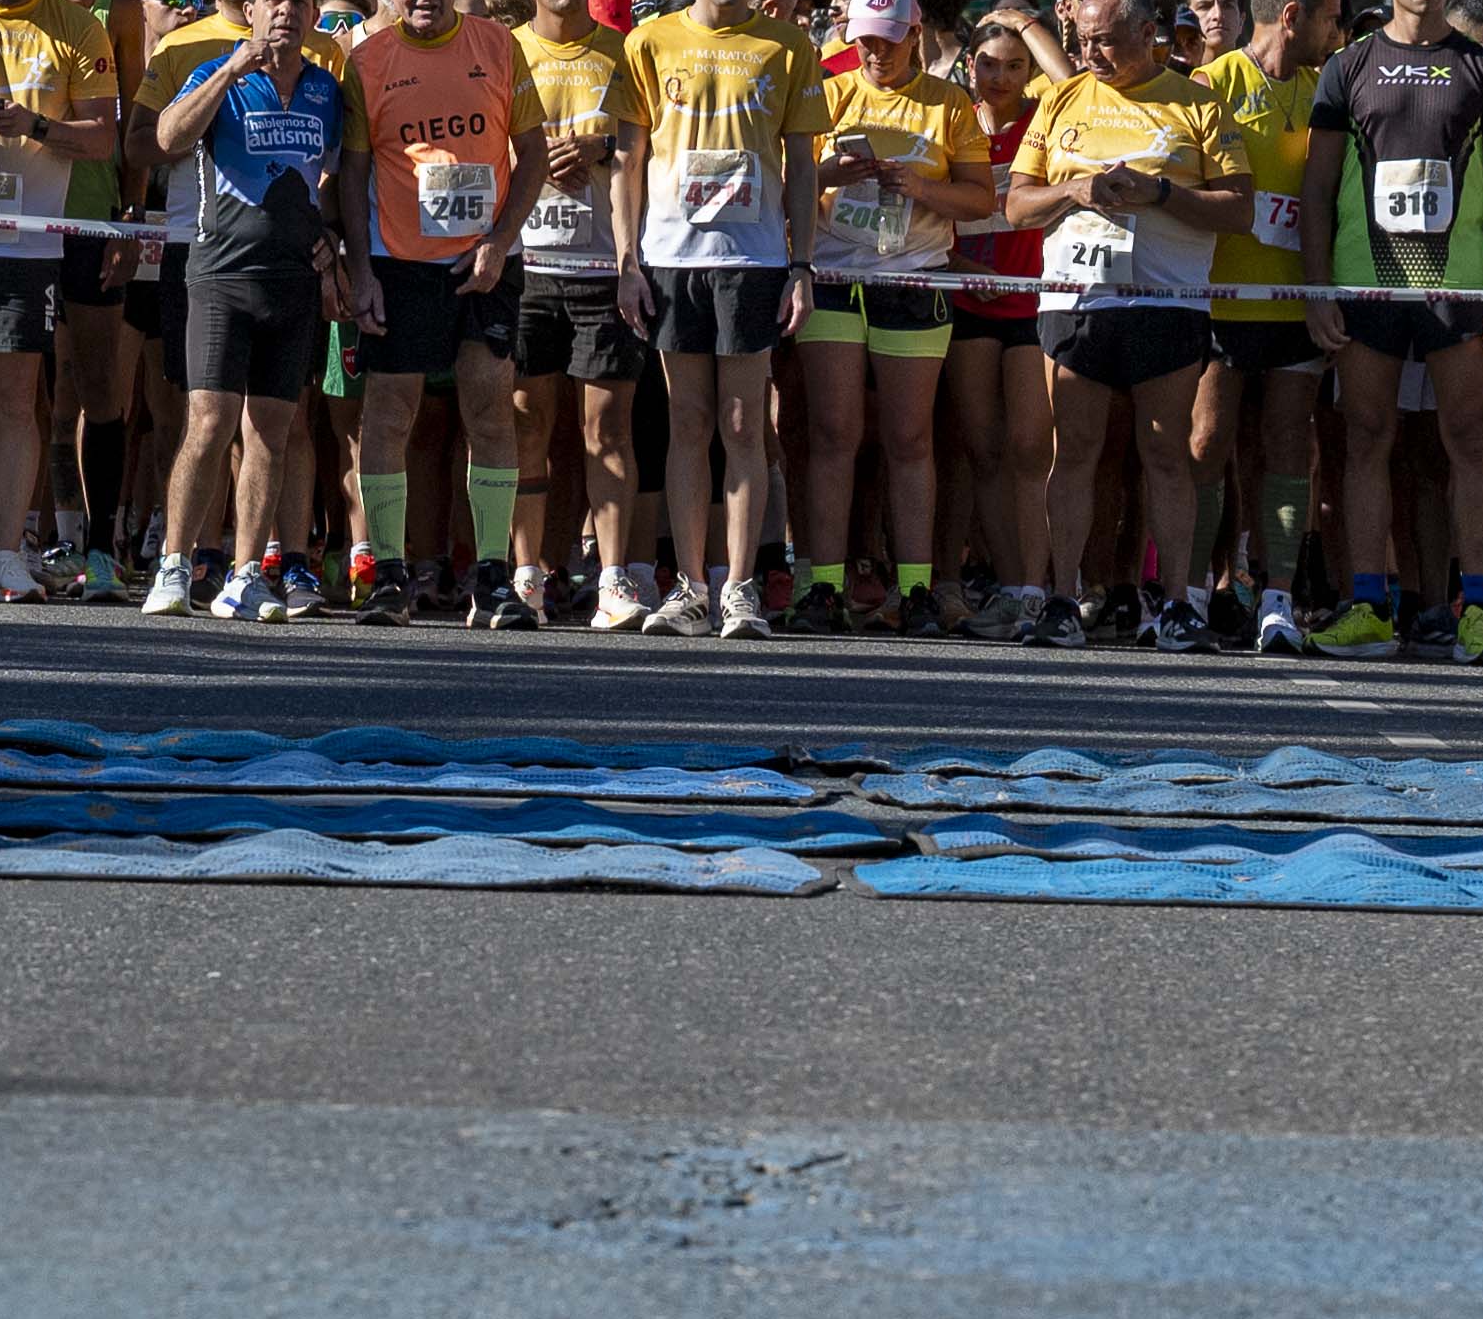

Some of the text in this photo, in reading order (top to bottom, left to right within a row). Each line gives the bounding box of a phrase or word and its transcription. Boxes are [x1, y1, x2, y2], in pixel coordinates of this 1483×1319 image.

[696, 48, 763, 64] MARATÓN
[693, 62, 751, 76] DORADA
[1378, 64, 1452, 79] VKX
[802, 87, 822, 99] MA
[249, 117, 320, 132] hablemos de
[399, 113, 486, 145] CIEGO
[248, 129, 323, 148] autismo
[431, 195, 484, 221] 245
[1269, 197, 1300, 229] 75
[1388, 191, 1439, 217] 318
[526, 204, 580, 230] 345
[45, 283, 55, 332] FILA
